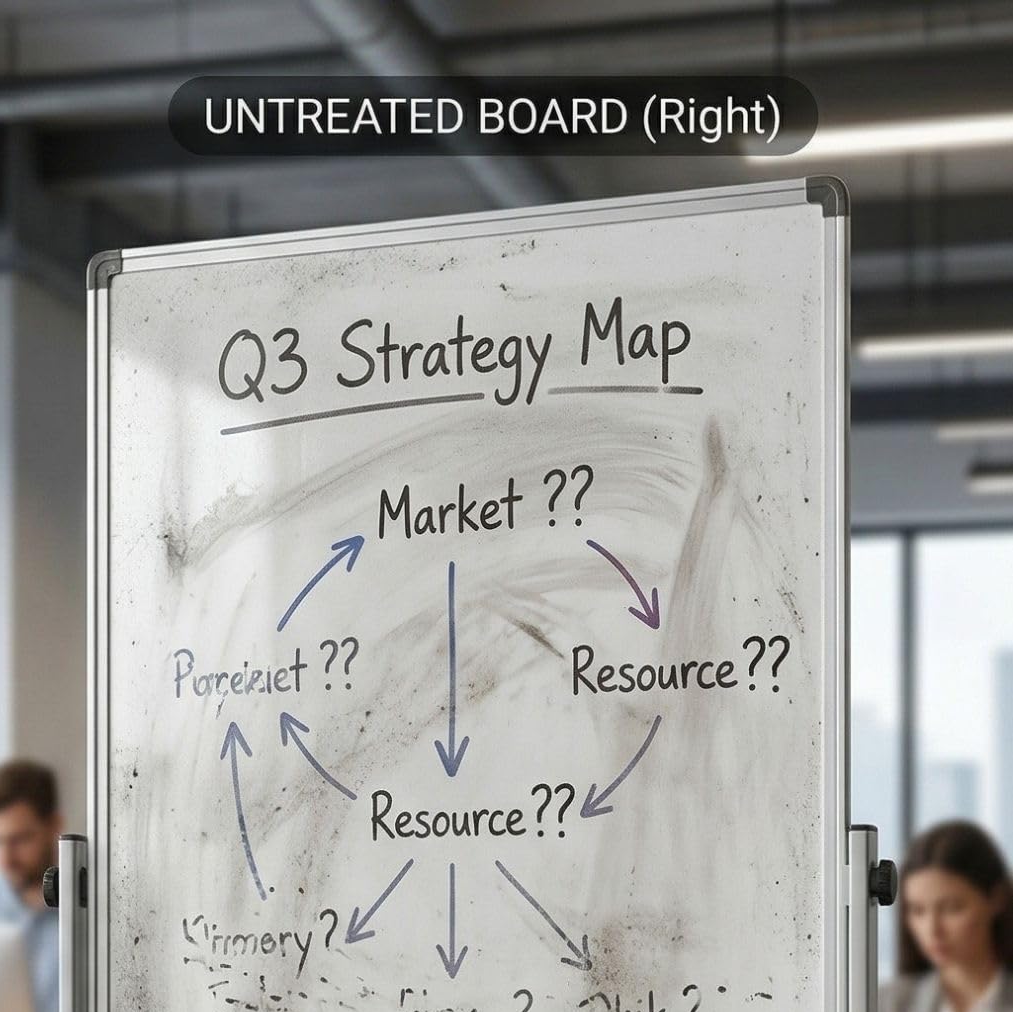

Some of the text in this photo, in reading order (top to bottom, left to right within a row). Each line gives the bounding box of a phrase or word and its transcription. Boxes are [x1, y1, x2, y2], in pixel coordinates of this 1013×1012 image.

[218, 296, 691, 409] Q3 Strategy Map
[378, 464, 594, 540] Market ??
[319, 636, 360, 691] ??
